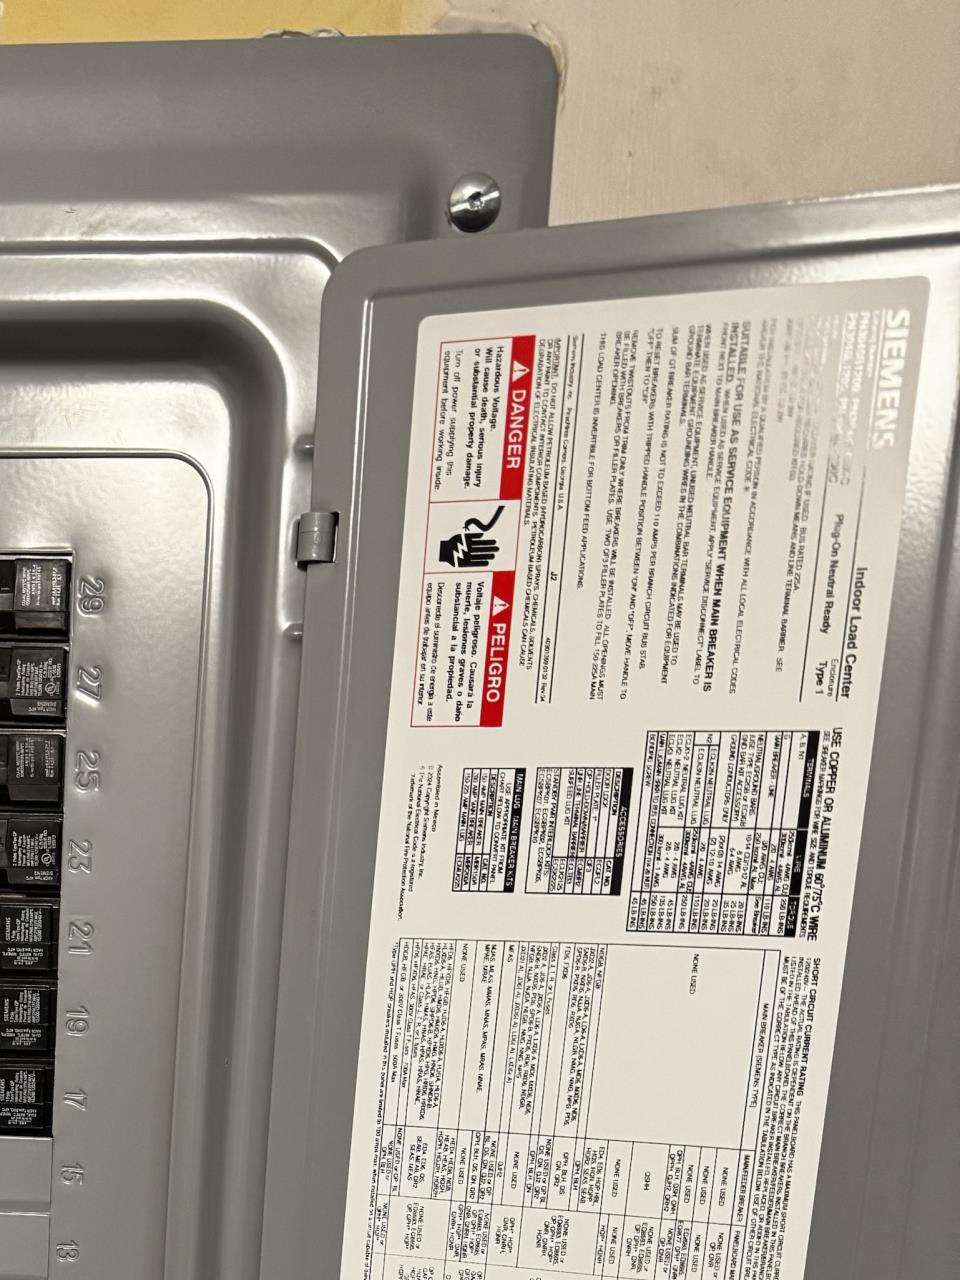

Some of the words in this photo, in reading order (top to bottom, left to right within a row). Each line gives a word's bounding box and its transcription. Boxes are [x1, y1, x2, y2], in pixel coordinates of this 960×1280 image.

[473, 348, 480, 357] or
[484, 346, 493, 363] Will
[598, 333, 606, 350] THIS
[736, 320, 751, 375] SUITABLE
[440, 350, 451, 394] equipment
[453, 350, 463, 367] Turn
[492, 346, 504, 393] Hazardous
[596, 352, 605, 373] LOAD
[452, 371, 461, 382] off
[469, 360, 481, 408] substantial
[592, 374, 602, 406] CENTER
[733, 377, 745, 401] FOR
[869, 307, 912, 449] SIEMENS
[438, 398, 448, 425] before
[449, 386, 458, 413] power
[478, 396, 489, 424] death,
[487, 396, 500, 431] Voltage.
[592, 407, 599, 415] IS
[730, 403, 742, 426] USE
[434, 428, 445, 462] working
[444, 417, 457, 457] supplying
[465, 411, 476, 449] property
[476, 427, 486, 459] serious
[505, 389, 527, 469] DANGER
[587, 416, 599, 459] INVERTIBLE
[728, 428, 739, 445] AS
[445, 461, 453, 476] this
[461, 452, 474, 488] damage.
[472, 462, 482, 488] injury
[586, 461, 594, 478] FOR
[723, 446, 737, 494] SERVICE
[583, 479, 593, 512] BOTTOM
[581, 513, 590, 534] FEED
[716, 496, 732, 561] EQUIPMENT
[827, 514, 844, 557] Plug-On
[712, 563, 725, 596] WHEN
[825, 559, 838, 598] Neutral
[850, 567, 867, 612] Indoor
[76, 575, 104, 618] 29
[451, 582, 463, 631] substancial
[462, 581, 473, 614] muerte,
[472, 581, 484, 611] Voltaje
[708, 598, 721, 627] MAIN
[818, 600, 834, 634] Ready
[845, 616, 862, 649] Load
[449, 644, 458, 652] la
[460, 618, 470, 655] lesiones
[468, 614, 481, 657] peligroso.
[485, 623, 506, 702] PELIGRO
[703, 629, 718, 680] BREAKER
[74, 665, 103, 708] 27
[443, 655, 456, 702] propiedad.
[455, 658, 465, 687] graves
[701, 682, 712, 692] IS
[813, 660, 828, 686] Type
[825, 658, 838, 697] Enclosure
[839, 653, 857, 698] Center
[465, 700, 474, 708] la
[830, 727, 843, 747] USE
[74, 750, 101, 793] 25
[514, 773, 523, 792] MAIN
[824, 751, 840, 793] COPPER
[512, 794, 521, 809] LUG
[822, 797, 834, 812] OR
[511, 815, 519, 833] MAIN
[614, 806, 627, 857] ACCESSORIES
[68, 839, 94, 874] 23
[506, 835, 517, 868] BREAKER
[815, 815, 832, 869] ALUMINUM
[68, 920, 95, 956] 21
[806, 915, 819, 941] WIRE
[809, 957, 821, 986] SHORT
[65, 1005, 90, 1037] 19
[805, 988, 817, 1022] CIRCUIT
[800, 1024, 812, 1064] CURRENT
[796, 1065, 807, 1096] RATING
[64, 1089, 89, 1111] 17
[61, 1162, 85, 1186] 15
[56, 1239, 80, 1264] 13
